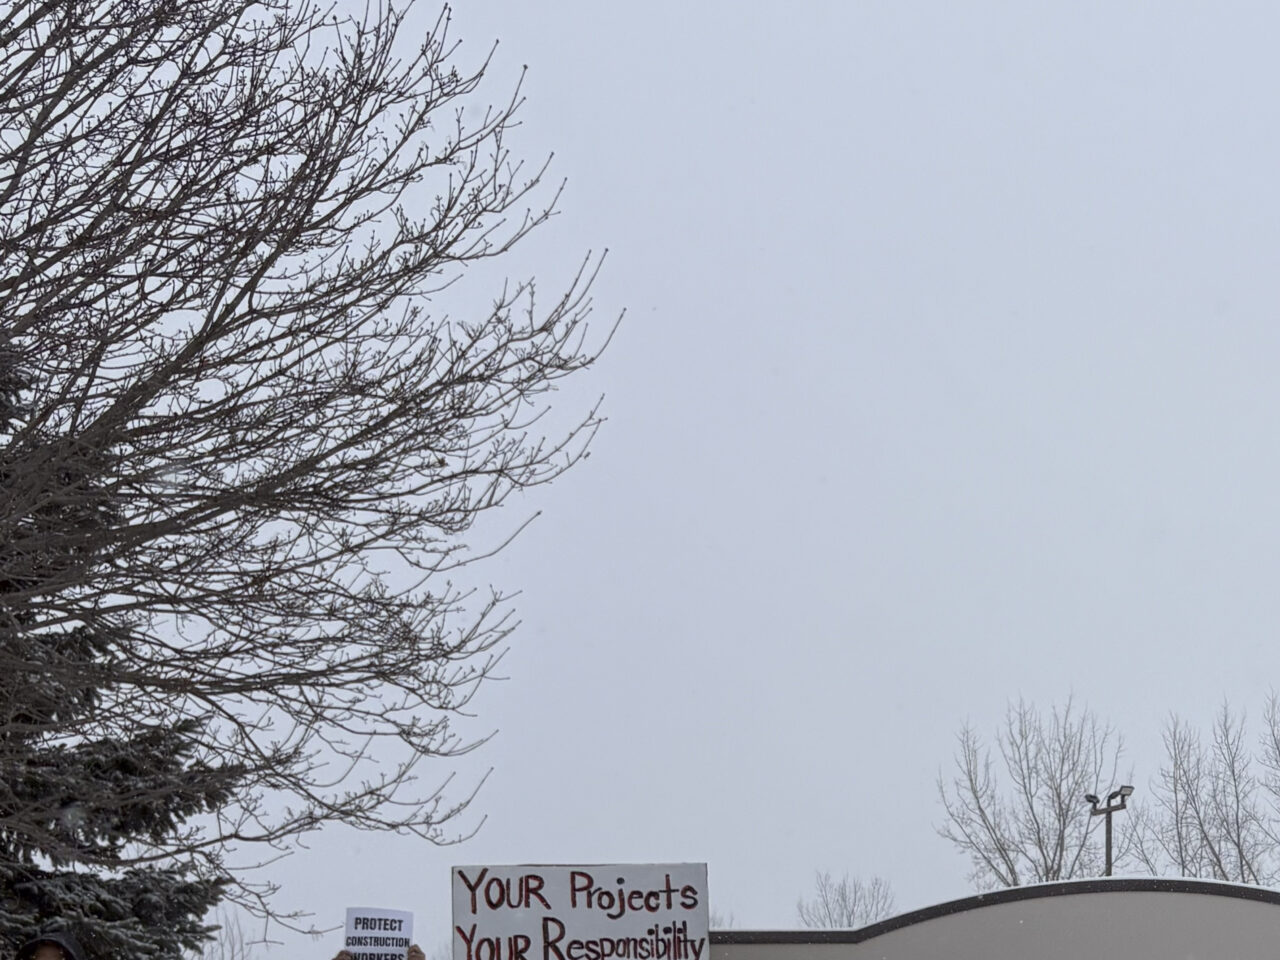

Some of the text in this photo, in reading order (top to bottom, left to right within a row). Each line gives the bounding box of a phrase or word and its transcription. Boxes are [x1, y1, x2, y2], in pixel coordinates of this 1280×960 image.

[458, 868, 699, 919] YOUR Projects
[354, 917, 404, 932] PROTECT
[345, 936, 410, 948] CONSTRUCTION
